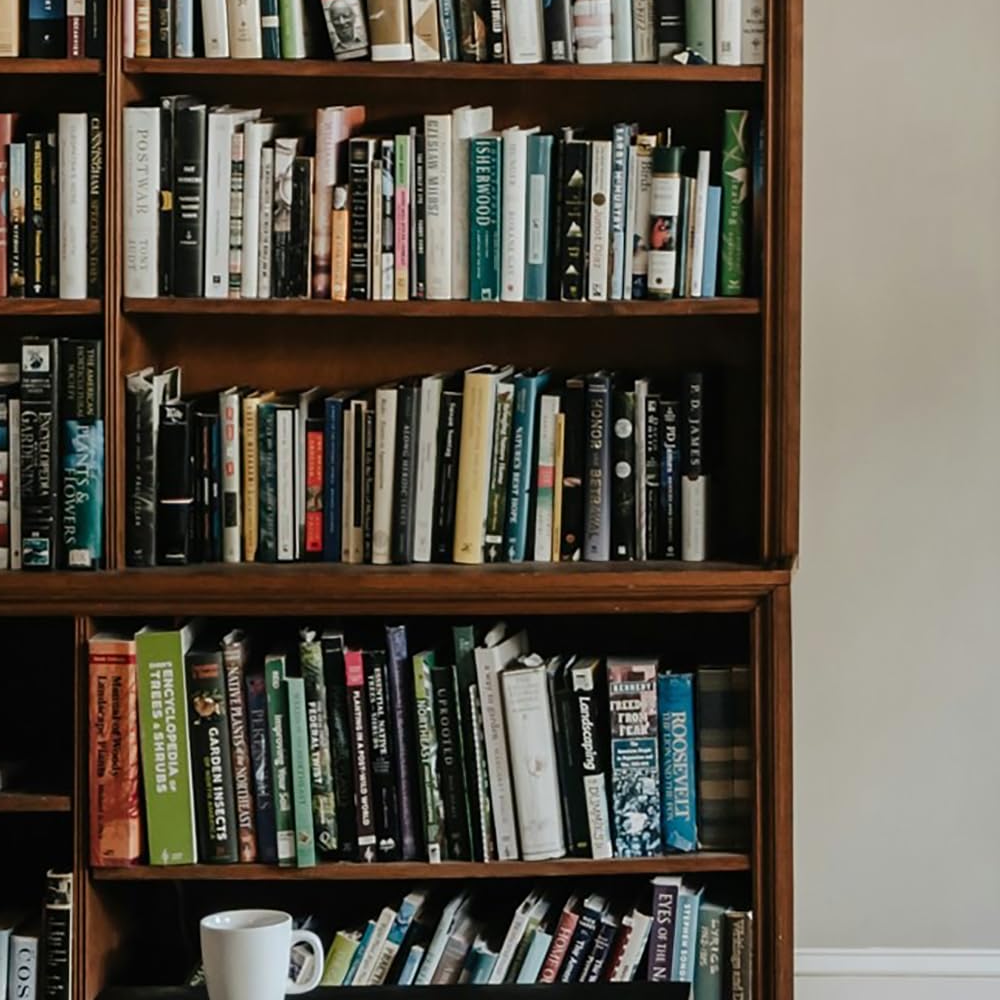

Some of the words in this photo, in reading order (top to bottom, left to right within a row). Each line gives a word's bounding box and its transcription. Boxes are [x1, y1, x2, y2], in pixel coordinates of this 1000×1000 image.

[136, 129, 148, 214] POSTWAR
[476, 141, 491, 226] ISHERWOOD
[641, 161, 650, 192] Birds
[128, 240, 136, 271] JUDT
[139, 240, 148, 270] TONY
[87, 349, 95, 366] THE
[87, 369, 95, 415] AMERICAN
[690, 400, 699, 411] D.
[691, 385, 699, 394] P.
[591, 399, 602, 448] HONOR
[667, 426, 675, 441] PD
[690, 419, 699, 465] JAMES
[75, 426, 90, 486] PLANTS
[665, 444, 676, 472] James
[64, 468, 76, 543] FLOWERS
[76, 491, 90, 504] &
[510, 498, 518, 523] HOPE
[111, 676, 121, 719] Manual
[150, 670, 163, 719] TREES
[227, 666, 237, 704] NATIVE
[374, 668, 383, 715] ESSENTIAL
[97, 676, 107, 739] Landscape
[163, 669, 178, 776] ENCYCLOPEDIA
[229, 705, 242, 747] PLANTS
[308, 702, 318, 749] FEDERAL
[437, 688, 453, 765] UPROOTED
[619, 712, 648, 723] FROM
[112, 723, 121, 735] of
[274, 715, 284, 765] Improving
[377, 720, 387, 754] NATIVE
[417, 700, 428, 765] NORTHEAST
[579, 697, 597, 769] Landscaping
[97, 741, 107, 777] Plants
[111, 738, 121, 776] Woody
[153, 731, 167, 792] SHRUBS
[208, 727, 222, 783] GARDEN
[312, 751, 323, 784] TWIST
[353, 691, 361, 731] PLANTING
[361, 796, 369, 825] WORLD
[672, 712, 689, 820] ROOSEVELT
[235, 767, 251, 828] NORTHEAST
[277, 768, 287, 790] Your
[213, 786, 227, 840] INSECTS
[280, 792, 290, 811] Soil
[657, 893, 672, 924] EYES
[547, 927, 572, 966] HOME
[656, 944, 666, 961] THE
[658, 927, 667, 939] OF
[710, 919, 719, 975] LYRICS
